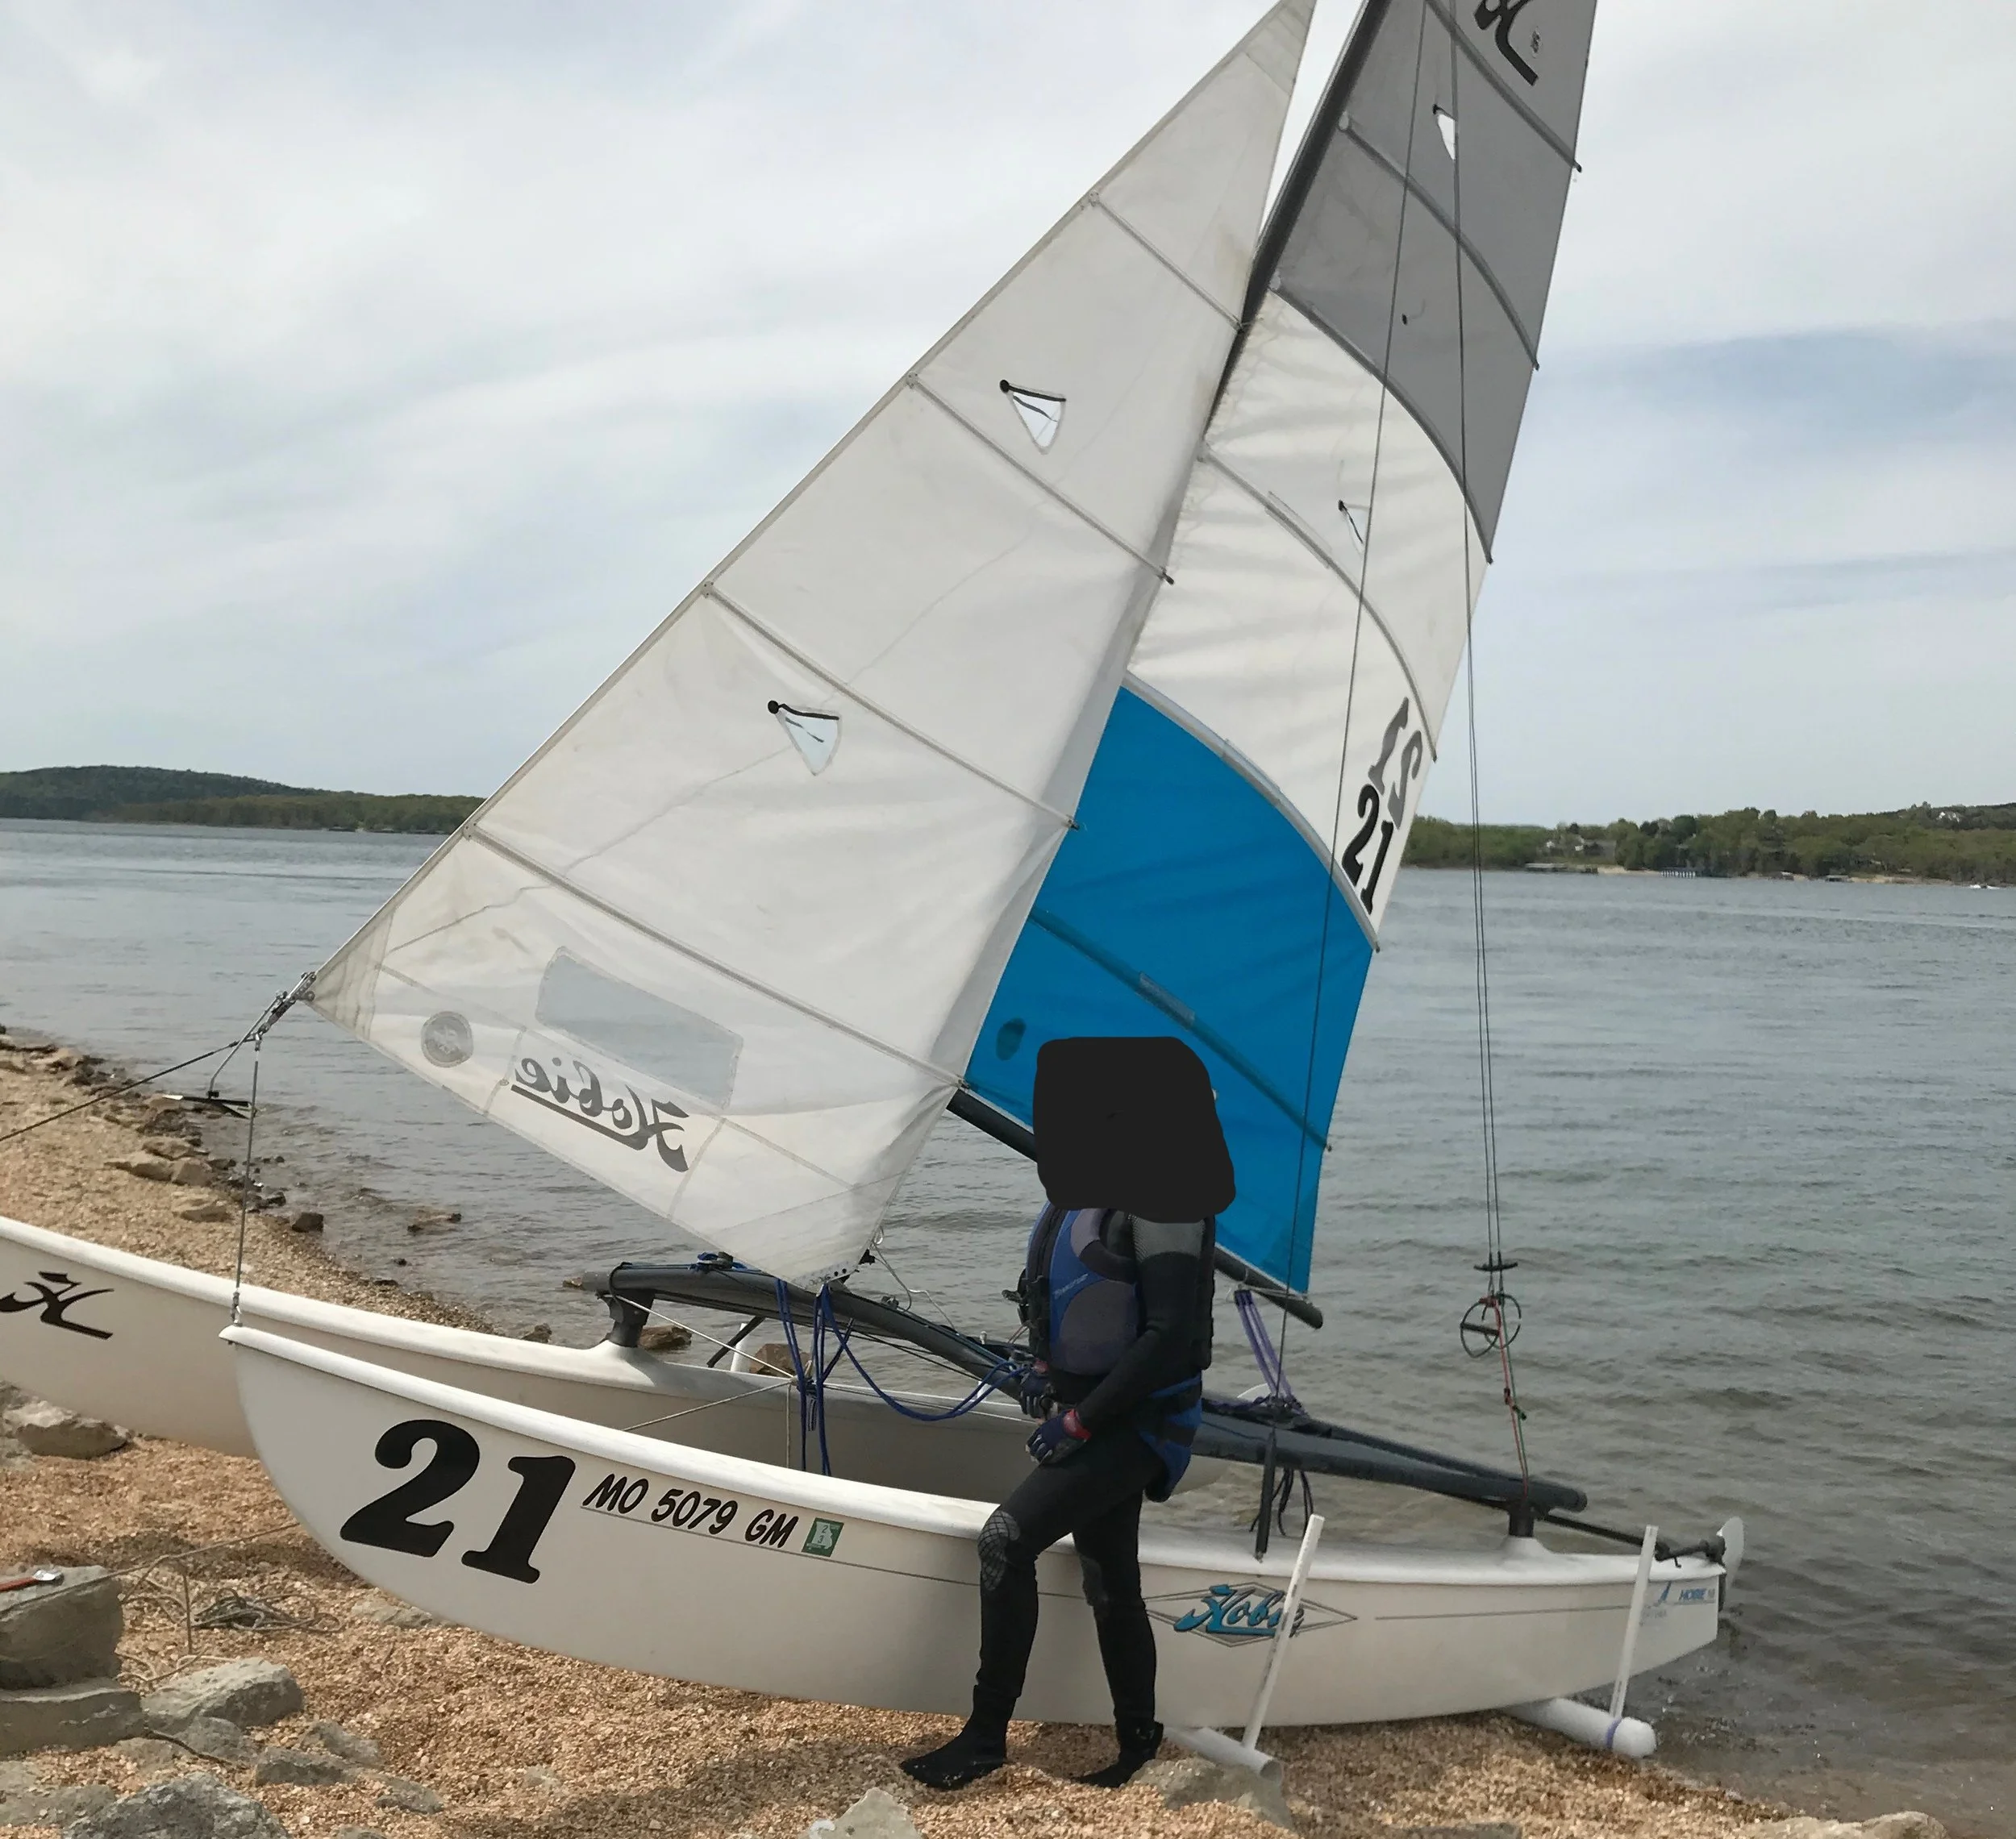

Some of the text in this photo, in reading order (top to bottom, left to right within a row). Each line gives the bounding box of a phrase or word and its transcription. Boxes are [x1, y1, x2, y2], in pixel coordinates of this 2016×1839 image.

[1341, 783, 1394, 915] 21
[339, 1419, 577, 1584] 21
[582, 1473, 799, 1549] MO 5079 GM
